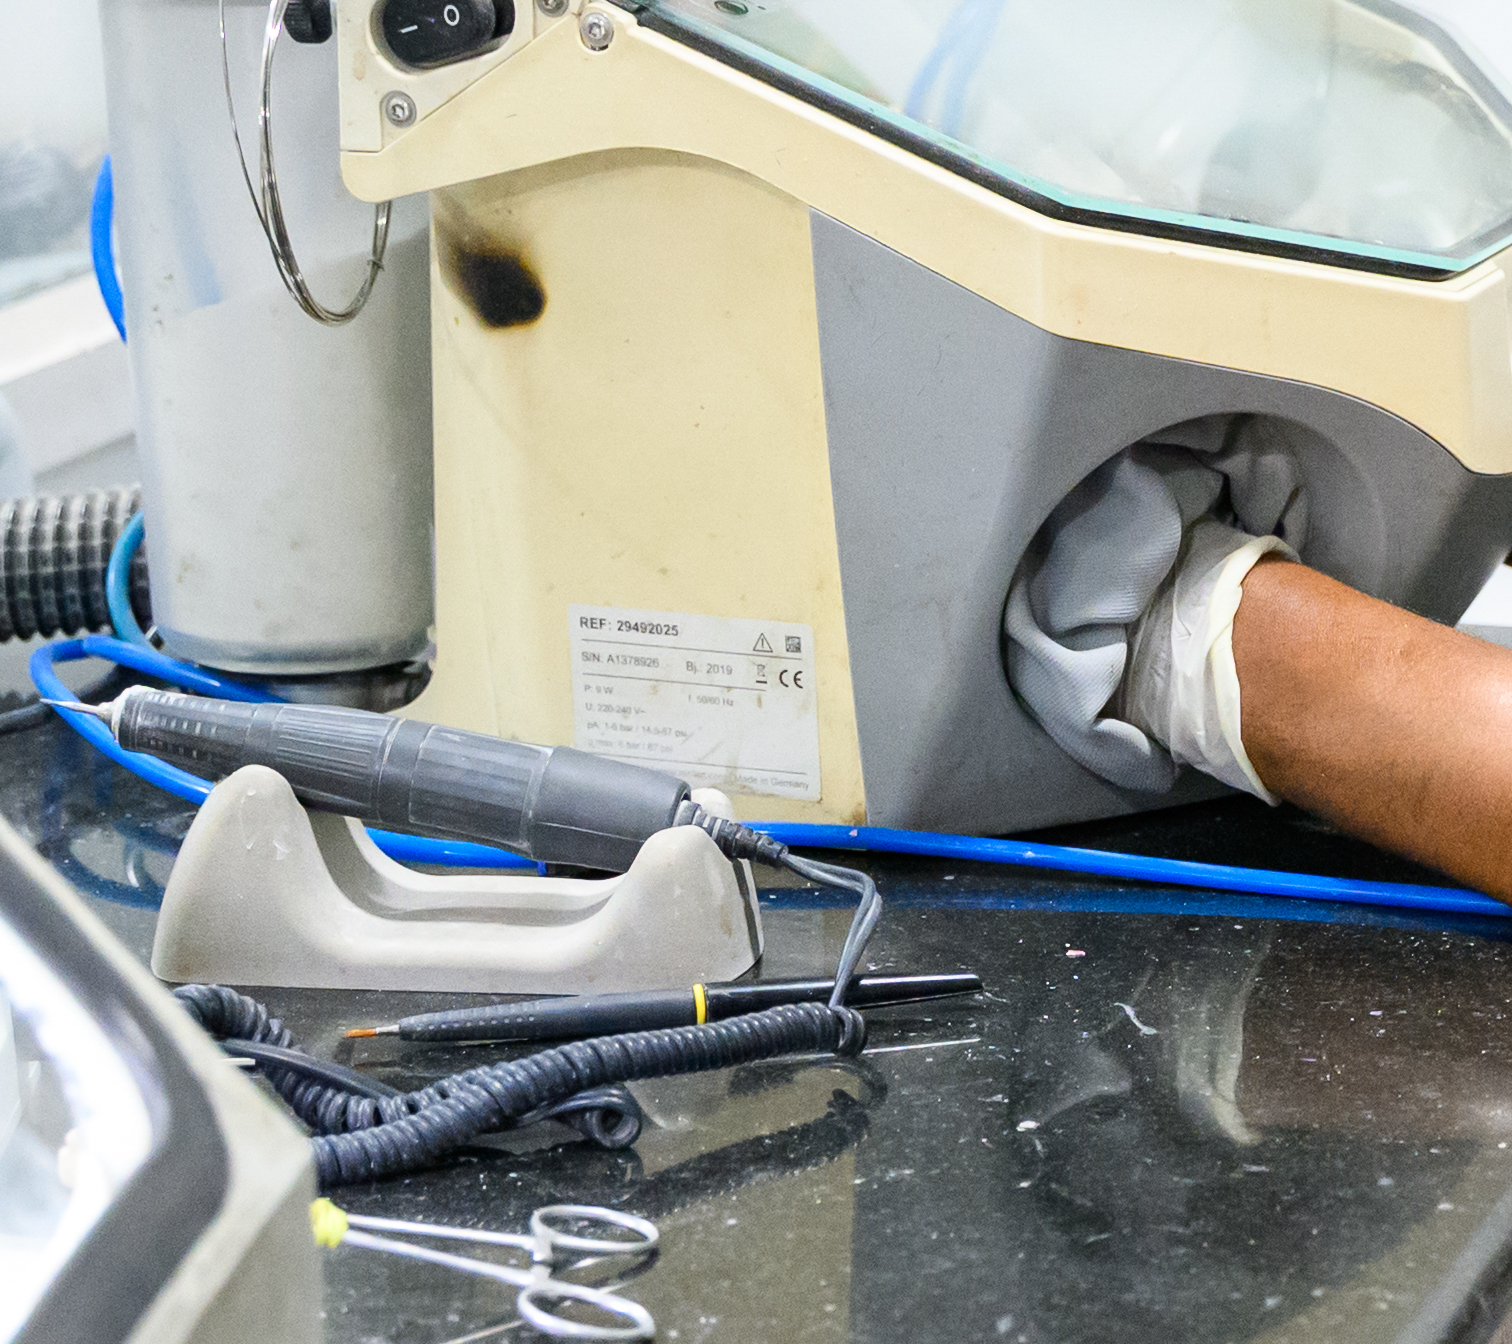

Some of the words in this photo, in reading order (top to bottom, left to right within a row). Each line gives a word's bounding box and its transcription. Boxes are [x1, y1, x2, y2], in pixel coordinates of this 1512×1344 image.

[580, 616, 612, 630] REF:
[617, 620, 679, 636] 29492025
[706, 663, 733, 676] 2019
